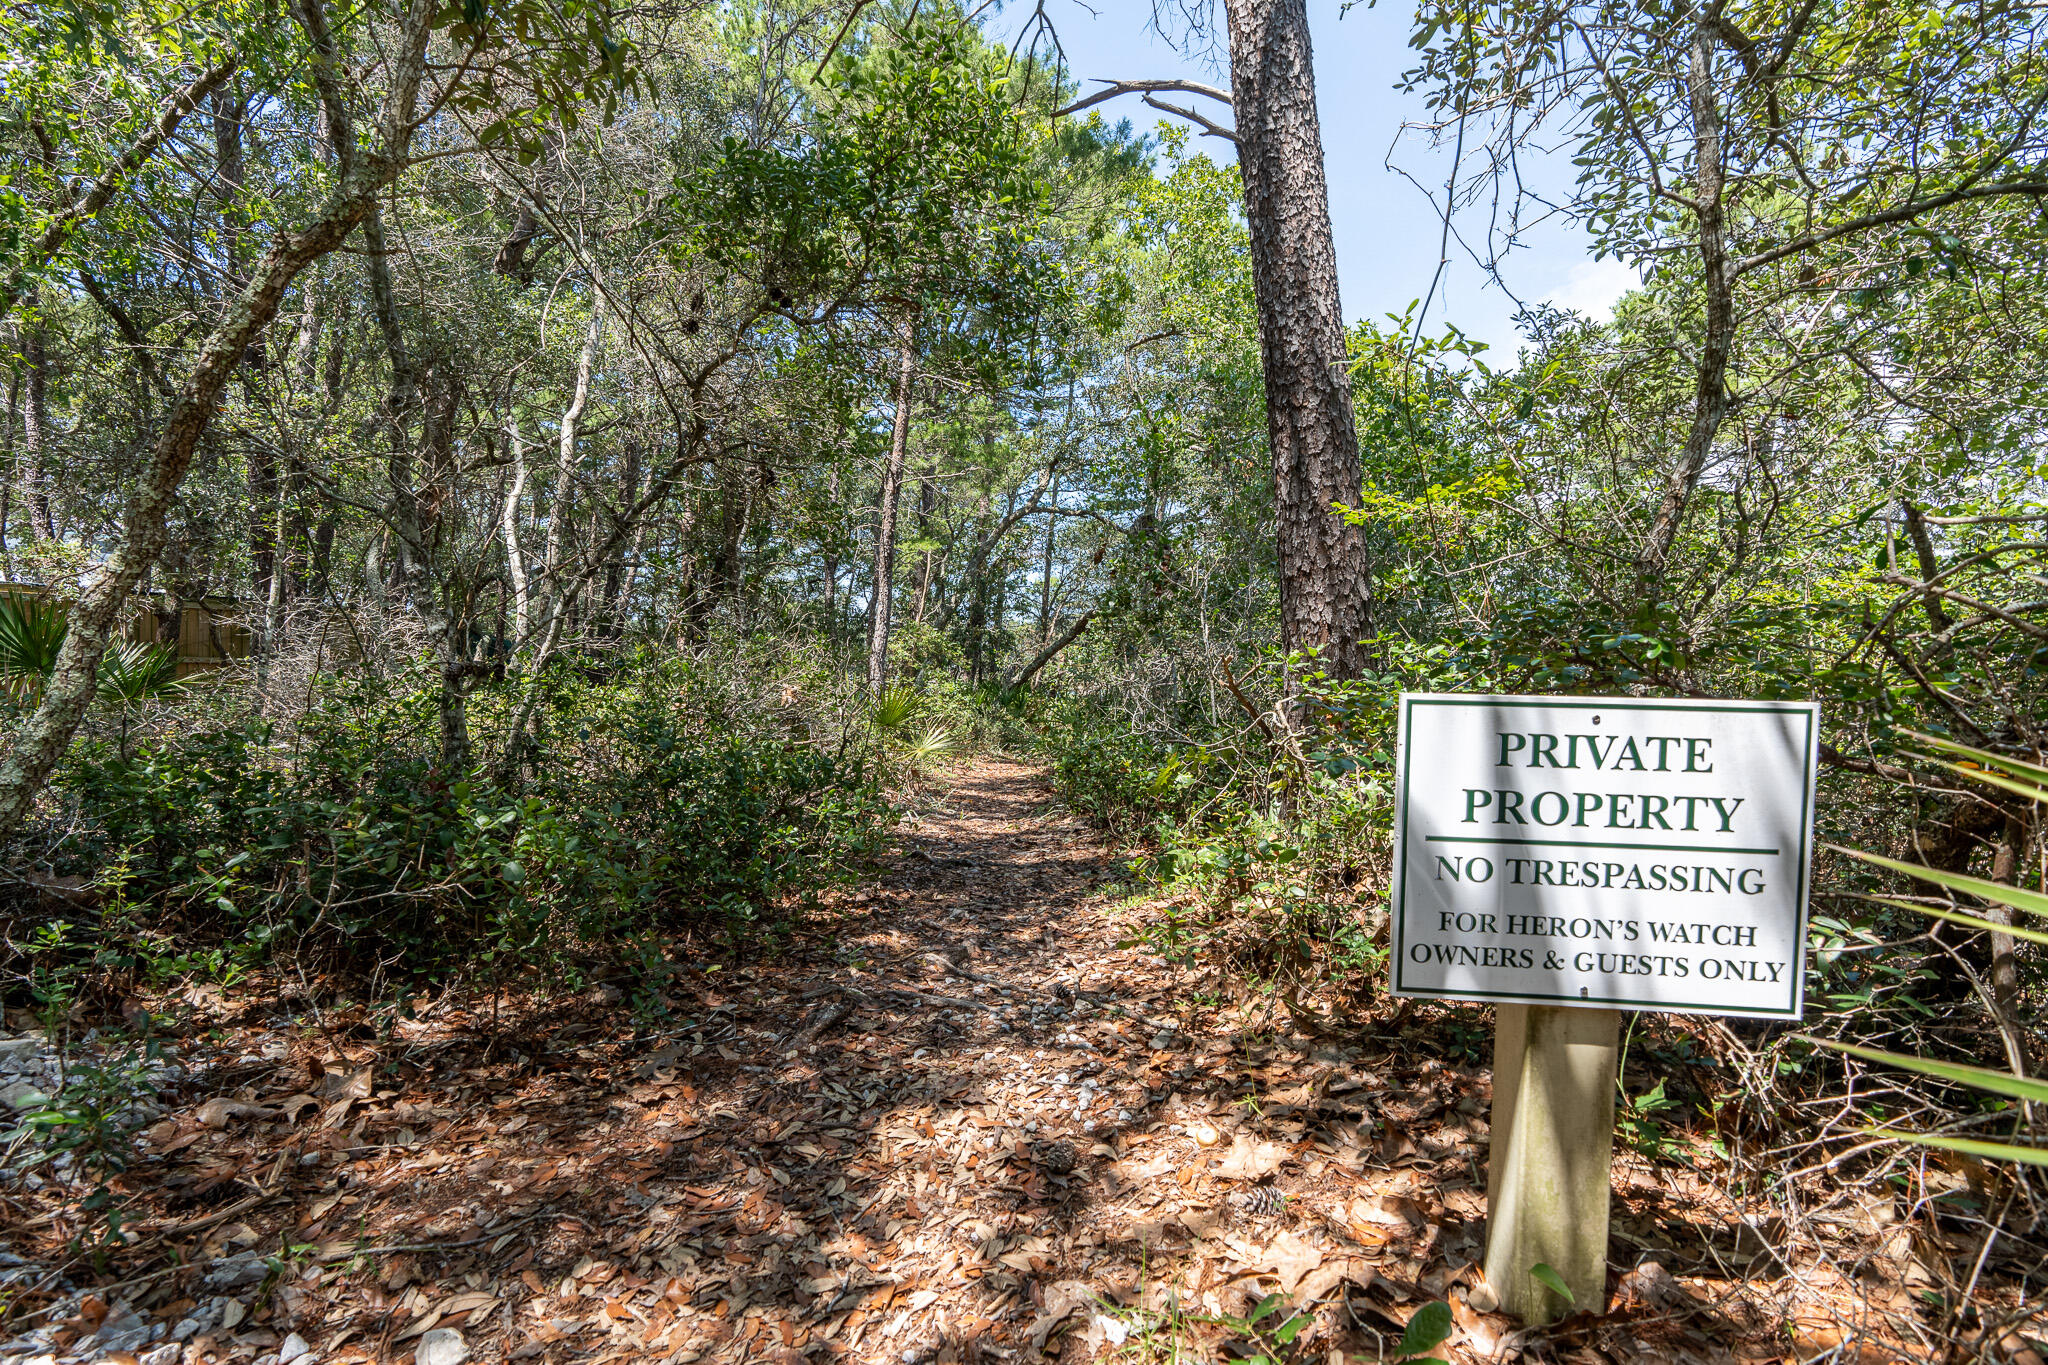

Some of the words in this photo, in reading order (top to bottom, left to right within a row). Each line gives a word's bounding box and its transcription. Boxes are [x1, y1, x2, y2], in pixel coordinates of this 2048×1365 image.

[1495, 732, 1713, 774] PRIVATE
[1461, 788, 1745, 833] PROPERTY
[1436, 855, 1494, 883] NO
[1505, 858, 1766, 895] TRESPASSING
[1438, 911, 1498, 933] FOR
[1506, 915, 1639, 941] HERON'S
[1648, 922, 1758, 947] WATCH
[1410, 943, 1534, 969] OWNERS
[1543, 950, 1565, 970] &
[1574, 952, 1689, 978] GUESTS
[1700, 958, 1786, 983] ONLY
